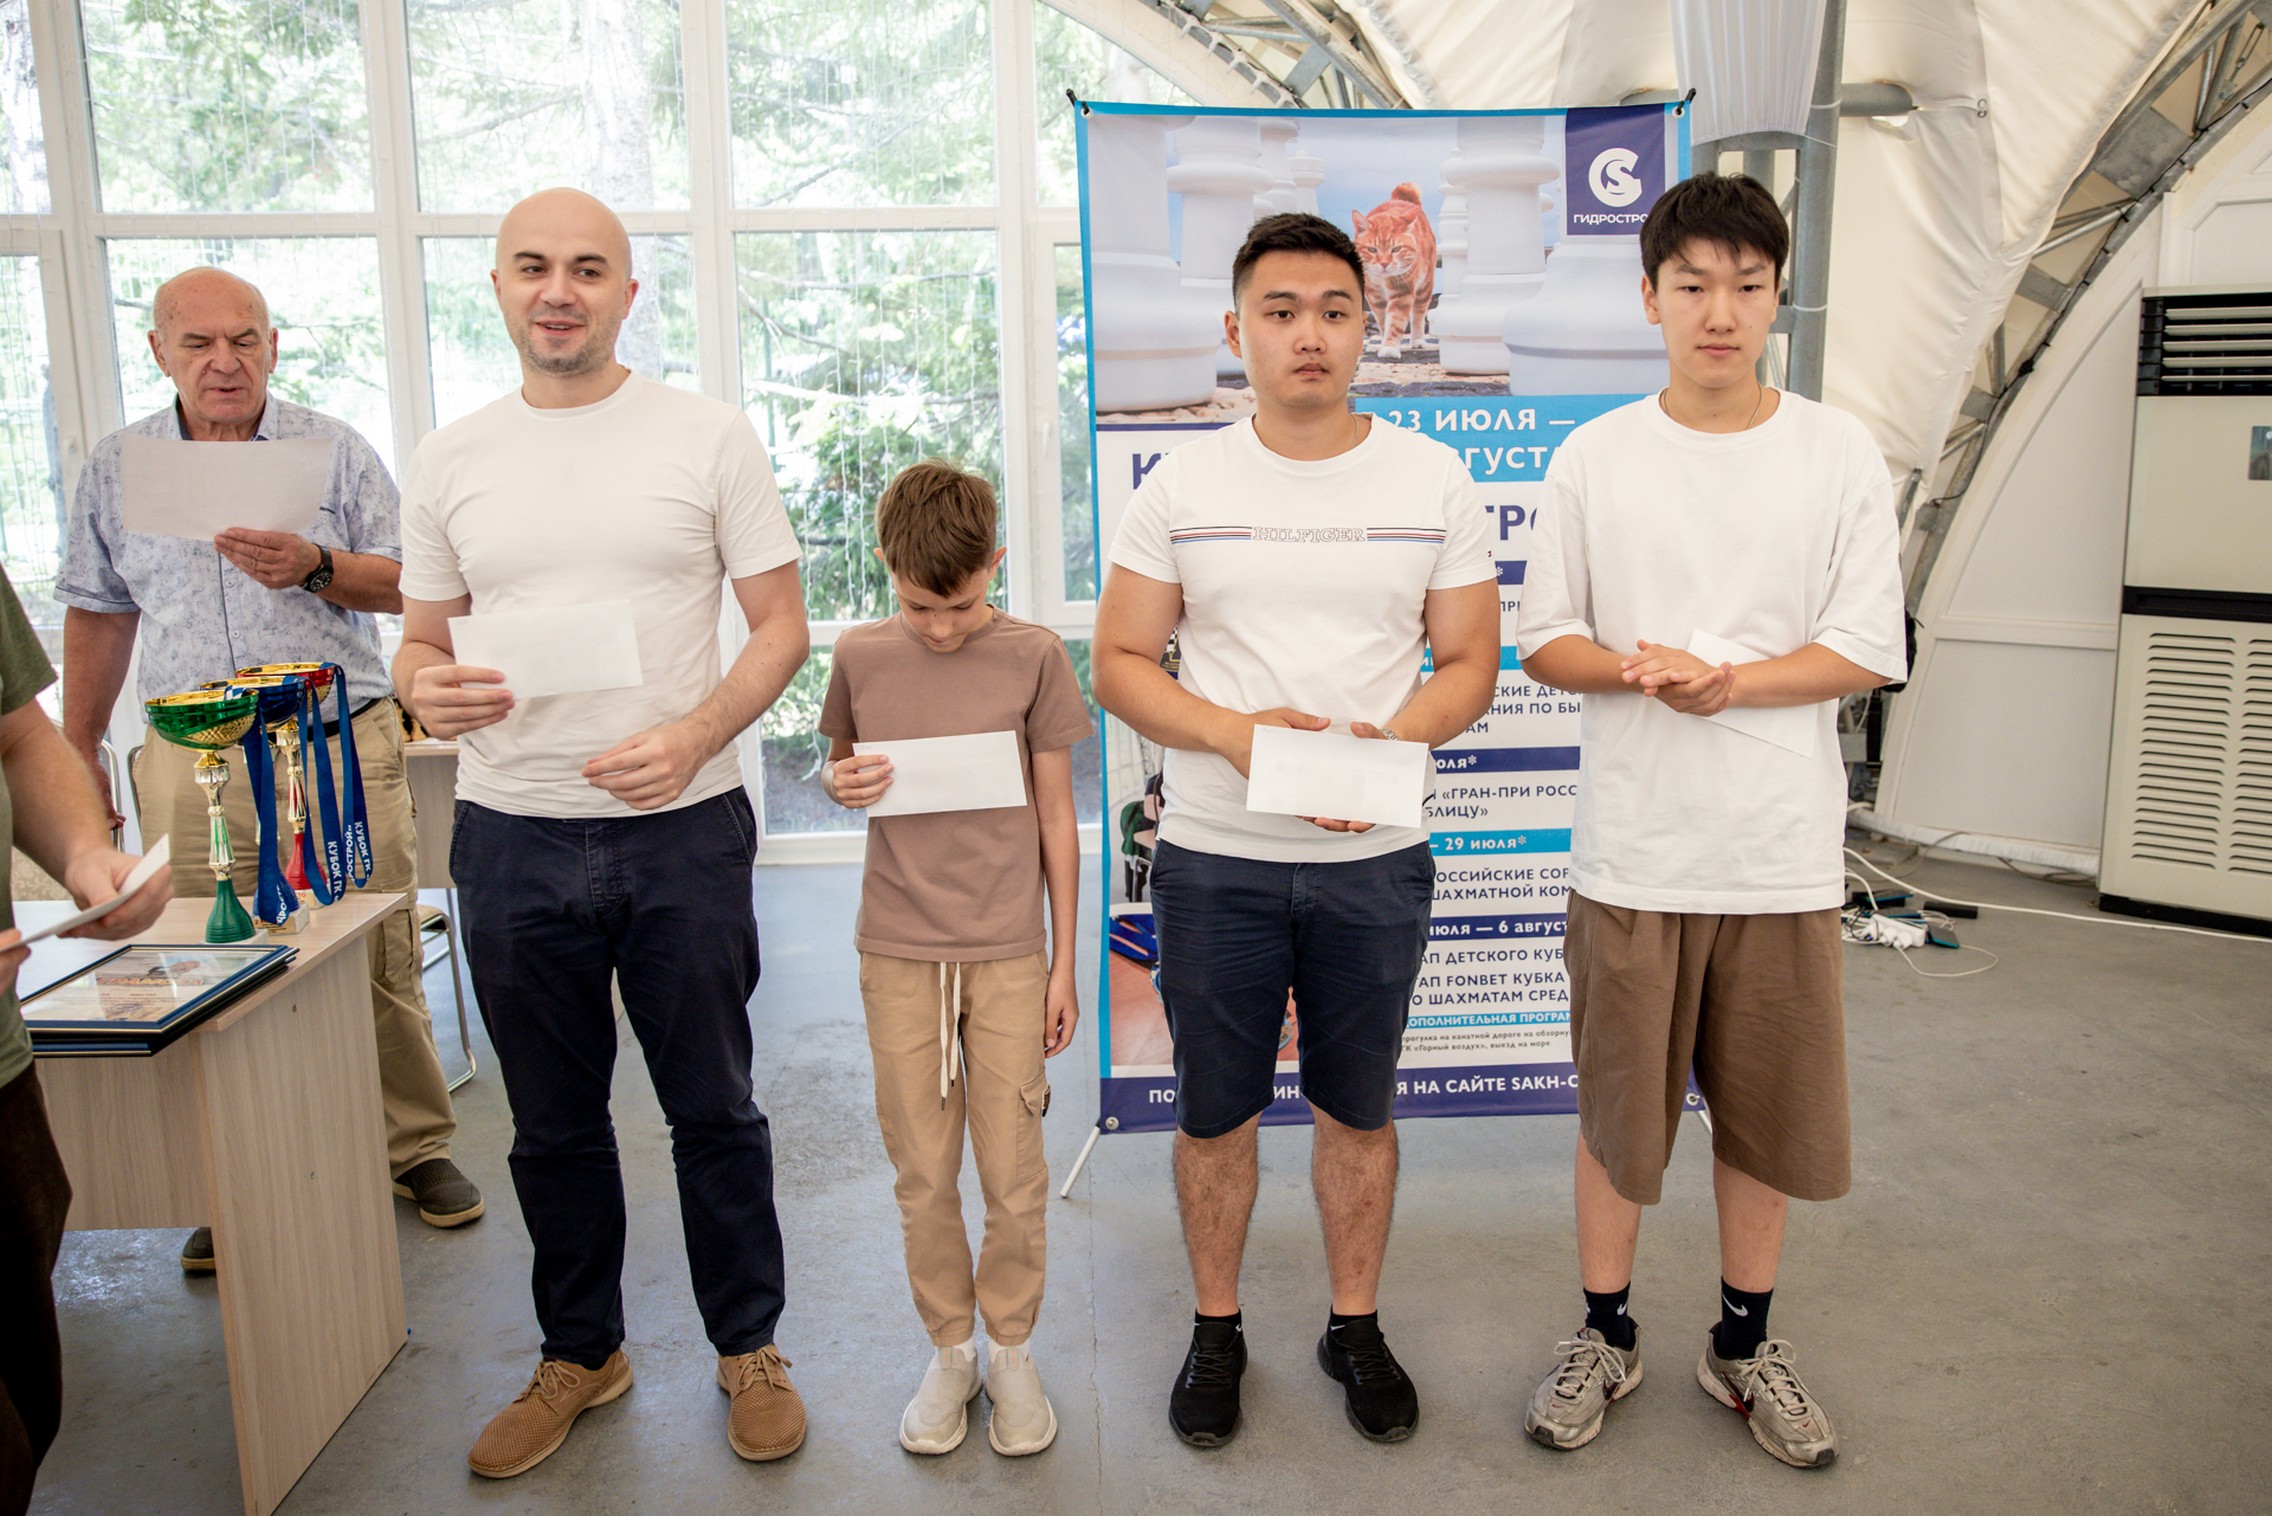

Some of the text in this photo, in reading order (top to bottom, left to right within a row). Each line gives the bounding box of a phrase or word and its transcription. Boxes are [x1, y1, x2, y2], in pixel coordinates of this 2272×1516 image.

[1573, 213, 1648, 226] ГИДРОСТРО
[1388, 410, 1421, 432] 23
[1435, 409, 1537, 432] ИЮЛЯ
[1464, 446, 1550, 476] ГУСТ
[1252, 526, 1366, 544] HILFIGER
[1486, 702, 1581, 716] НИЯ ПО БЫ
[1465, 722, 1489, 734] АМ
[1442, 786, 1531, 800] «ГРАН-ПРИ
[1536, 784, 1578, 798] РОСС
[354, 821, 369, 858] КУБОК
[1444, 837, 1465, 851] 29
[327, 841, 343, 879] КУБОК
[344, 824, 355, 882] РОСТРОЙ»
[1436, 866, 1569, 883] ОССИЙСКИЕ СОР
[333, 879, 343, 894] ГК
[1539, 885, 1570, 898] КОМ
[1498, 920, 1509, 934] 6
[1514, 920, 1568, 936] август
[1421, 948, 1564, 966] АП ДЕТСКОГО КУБ
[1416, 971, 1565, 988] АП FONBET КУБКА
[1411, 988, 1569, 1006] О ШАХМАТАМ СРЕД
[1408, 1011, 1571, 1028] ОПОЛНИТЕЛЬНАЯ ПРОГРАМ
[1536, 1029, 1569, 1039] обзорну
[1149, 1089, 1177, 1103] ПО
[1396, 1082, 1408, 1096] Я
[1414, 1080, 1441, 1095] НА
[1445, 1074, 1506, 1094] САЙТЕ
[1511, 1074, 1579, 1091] SAKH-C
